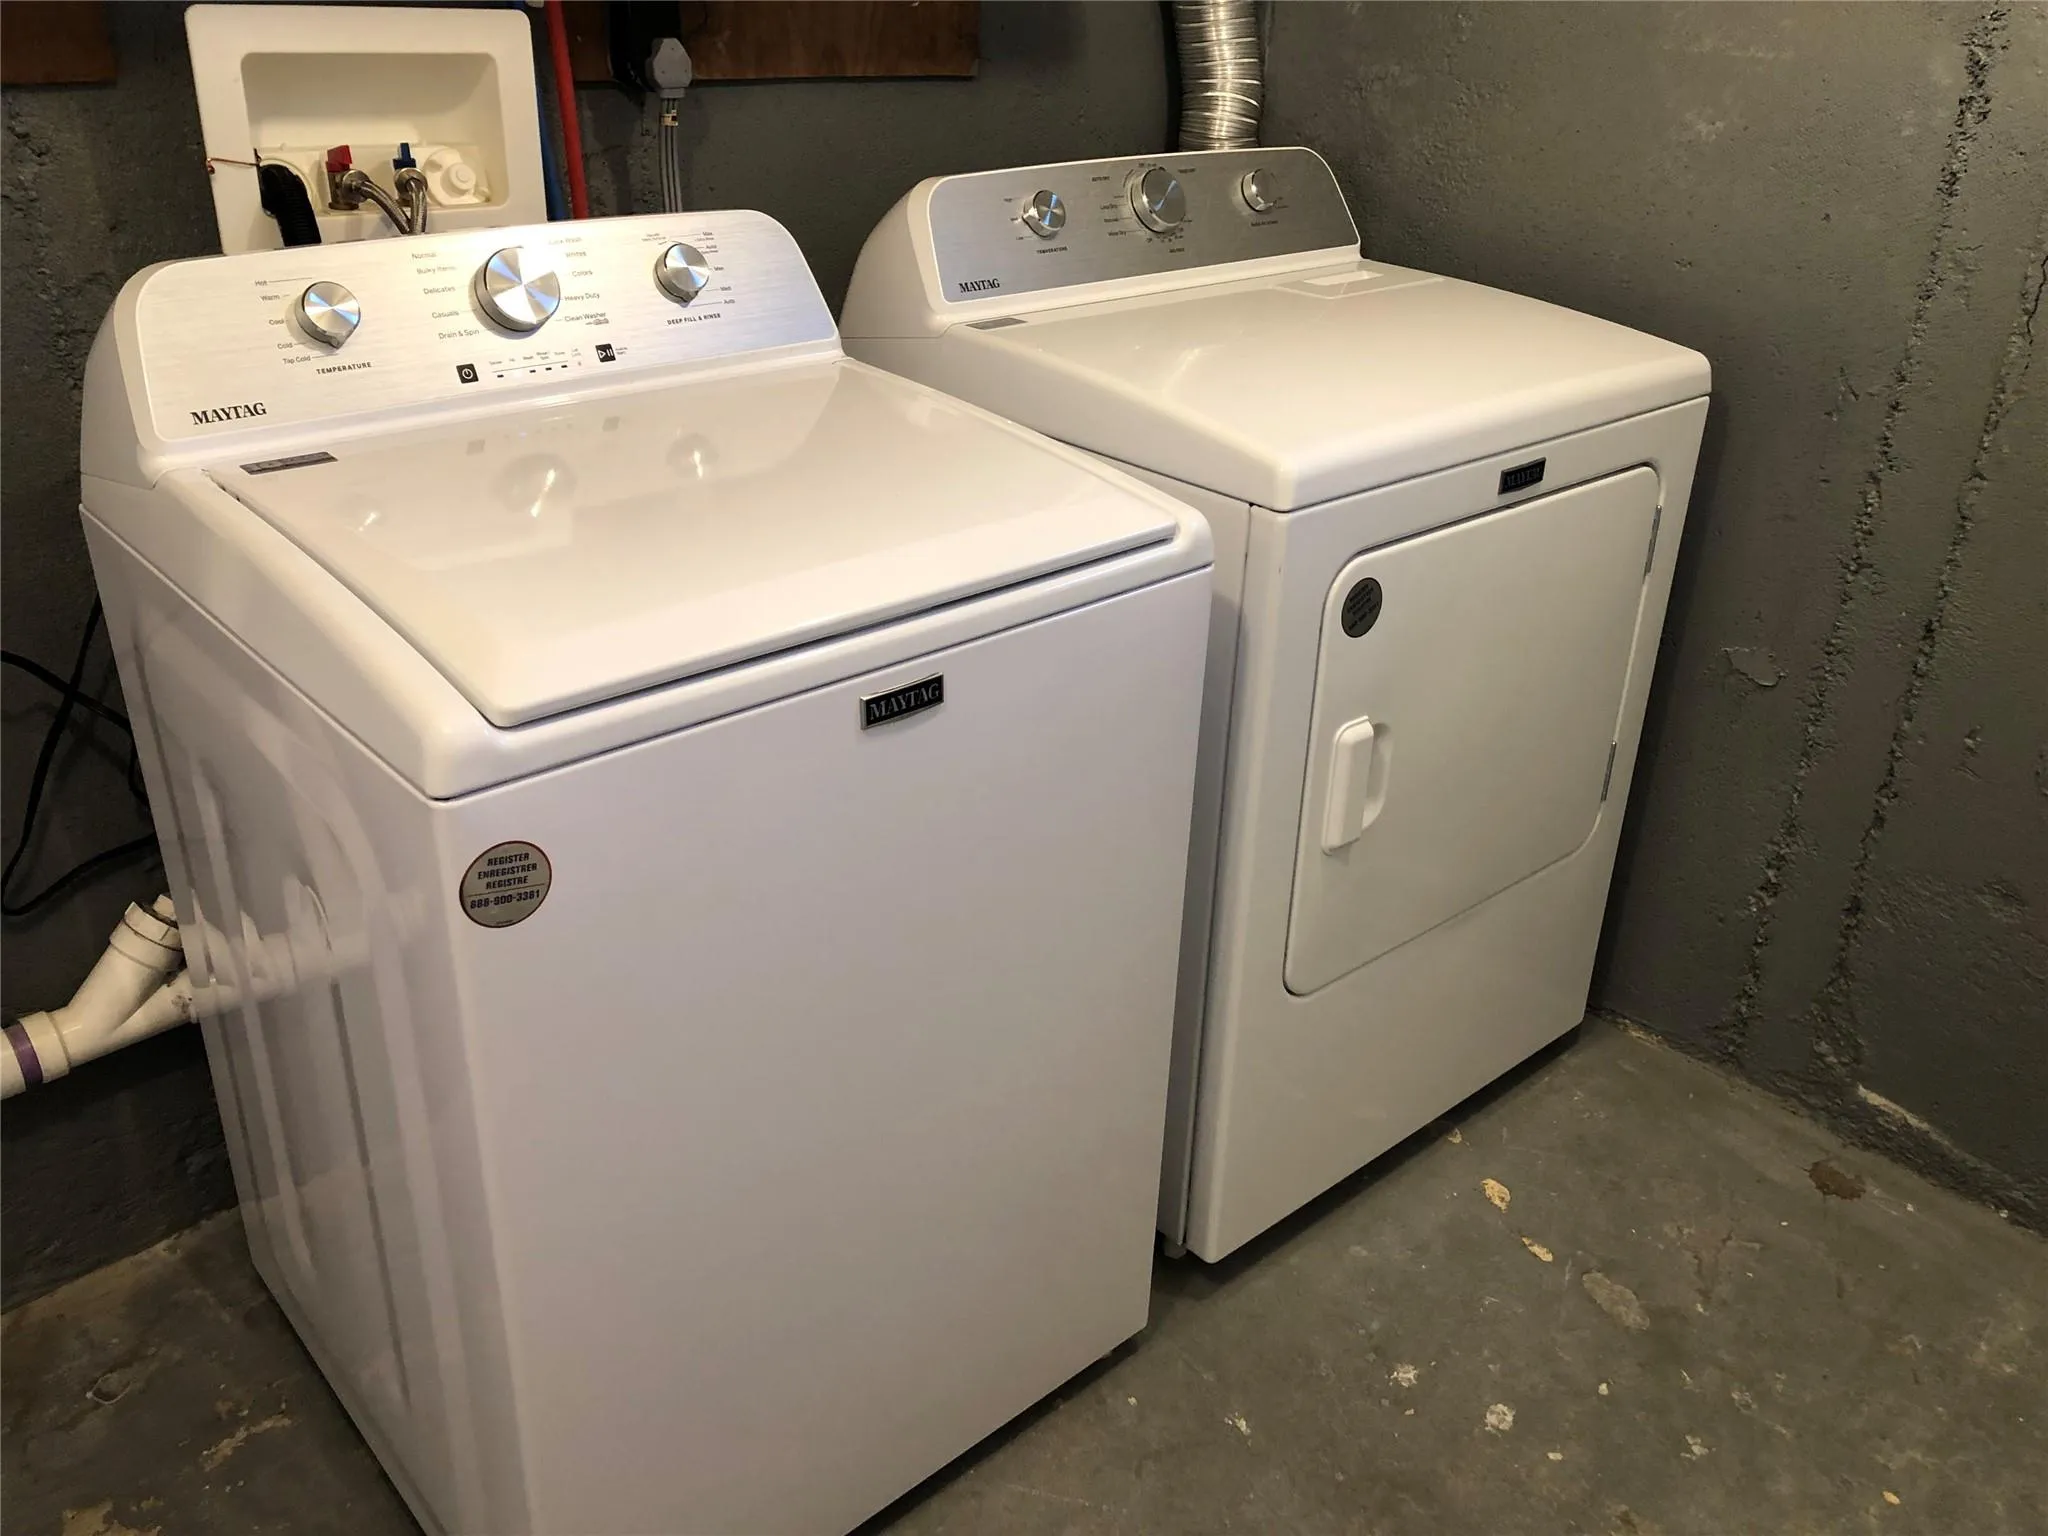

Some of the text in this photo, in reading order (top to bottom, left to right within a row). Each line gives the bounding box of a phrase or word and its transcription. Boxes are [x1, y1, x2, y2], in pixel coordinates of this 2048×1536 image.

[571, 270, 593, 278] Colors
[423, 286, 456, 295] Delicates
[958, 278, 1000, 293] MAYTAG
[260, 293, 280, 301] Warm
[564, 292, 600, 302] Heavy Duty
[431, 310, 460, 319] Casuals
[564, 314, 583, 322] Clean
[583, 312, 606, 320] Washer
[268, 318, 285, 326] Cool
[438, 331, 457, 340] Drain
[464, 329, 480, 337] Spin
[283, 354, 311, 365] Tap Cold
[316, 361, 372, 375] TEMPERATURE
[190, 402, 267, 425] MAYTAG
[870, 683, 940, 720] MAYTAG
[487, 853, 530, 866] REGISTER
[477, 863, 538, 880] ENREGISTRER
[486, 876, 529, 889] REGISTRE
